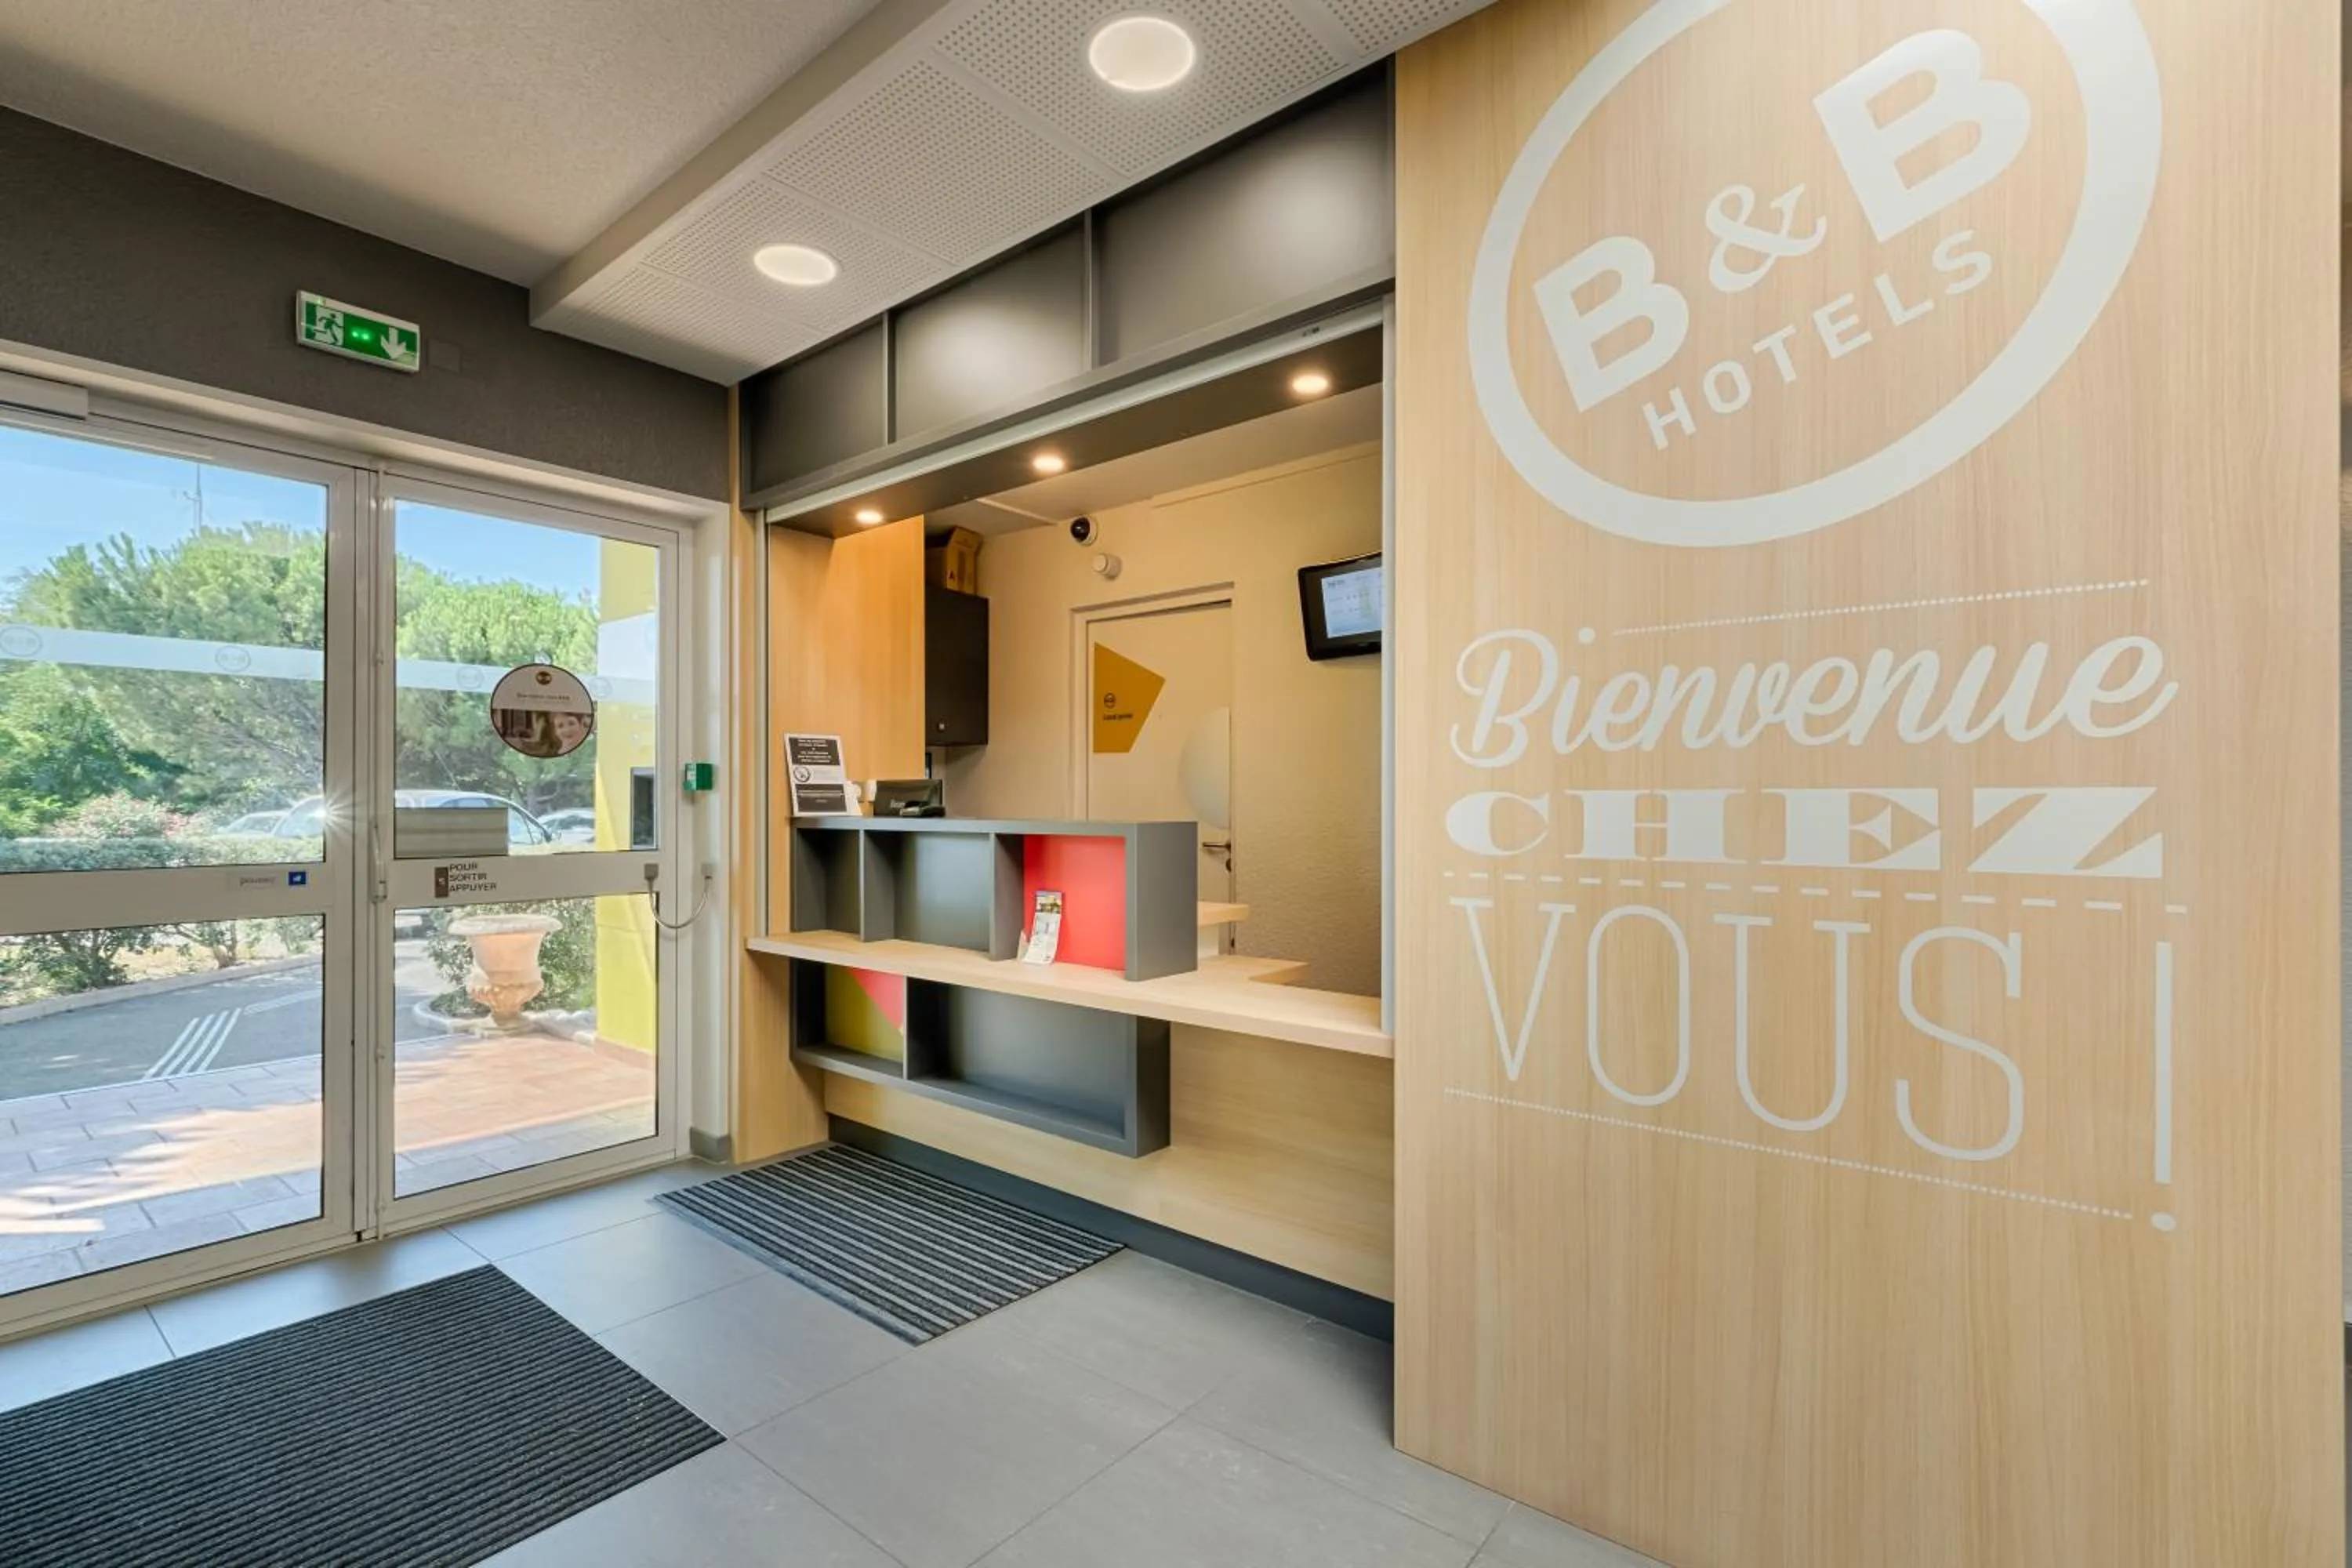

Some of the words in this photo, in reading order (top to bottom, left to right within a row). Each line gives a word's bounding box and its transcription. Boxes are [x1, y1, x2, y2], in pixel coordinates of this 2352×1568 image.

[1532, 28, 2032, 412] B&B
[1641, 227, 1995, 450] HOTELS
[1450, 627, 2179, 770] Bienvenue
[450, 883, 497, 891] APPUYER
[1445, 786, 2165, 880] CHEZ
[1449, 897, 2024, 1162] VOUS
